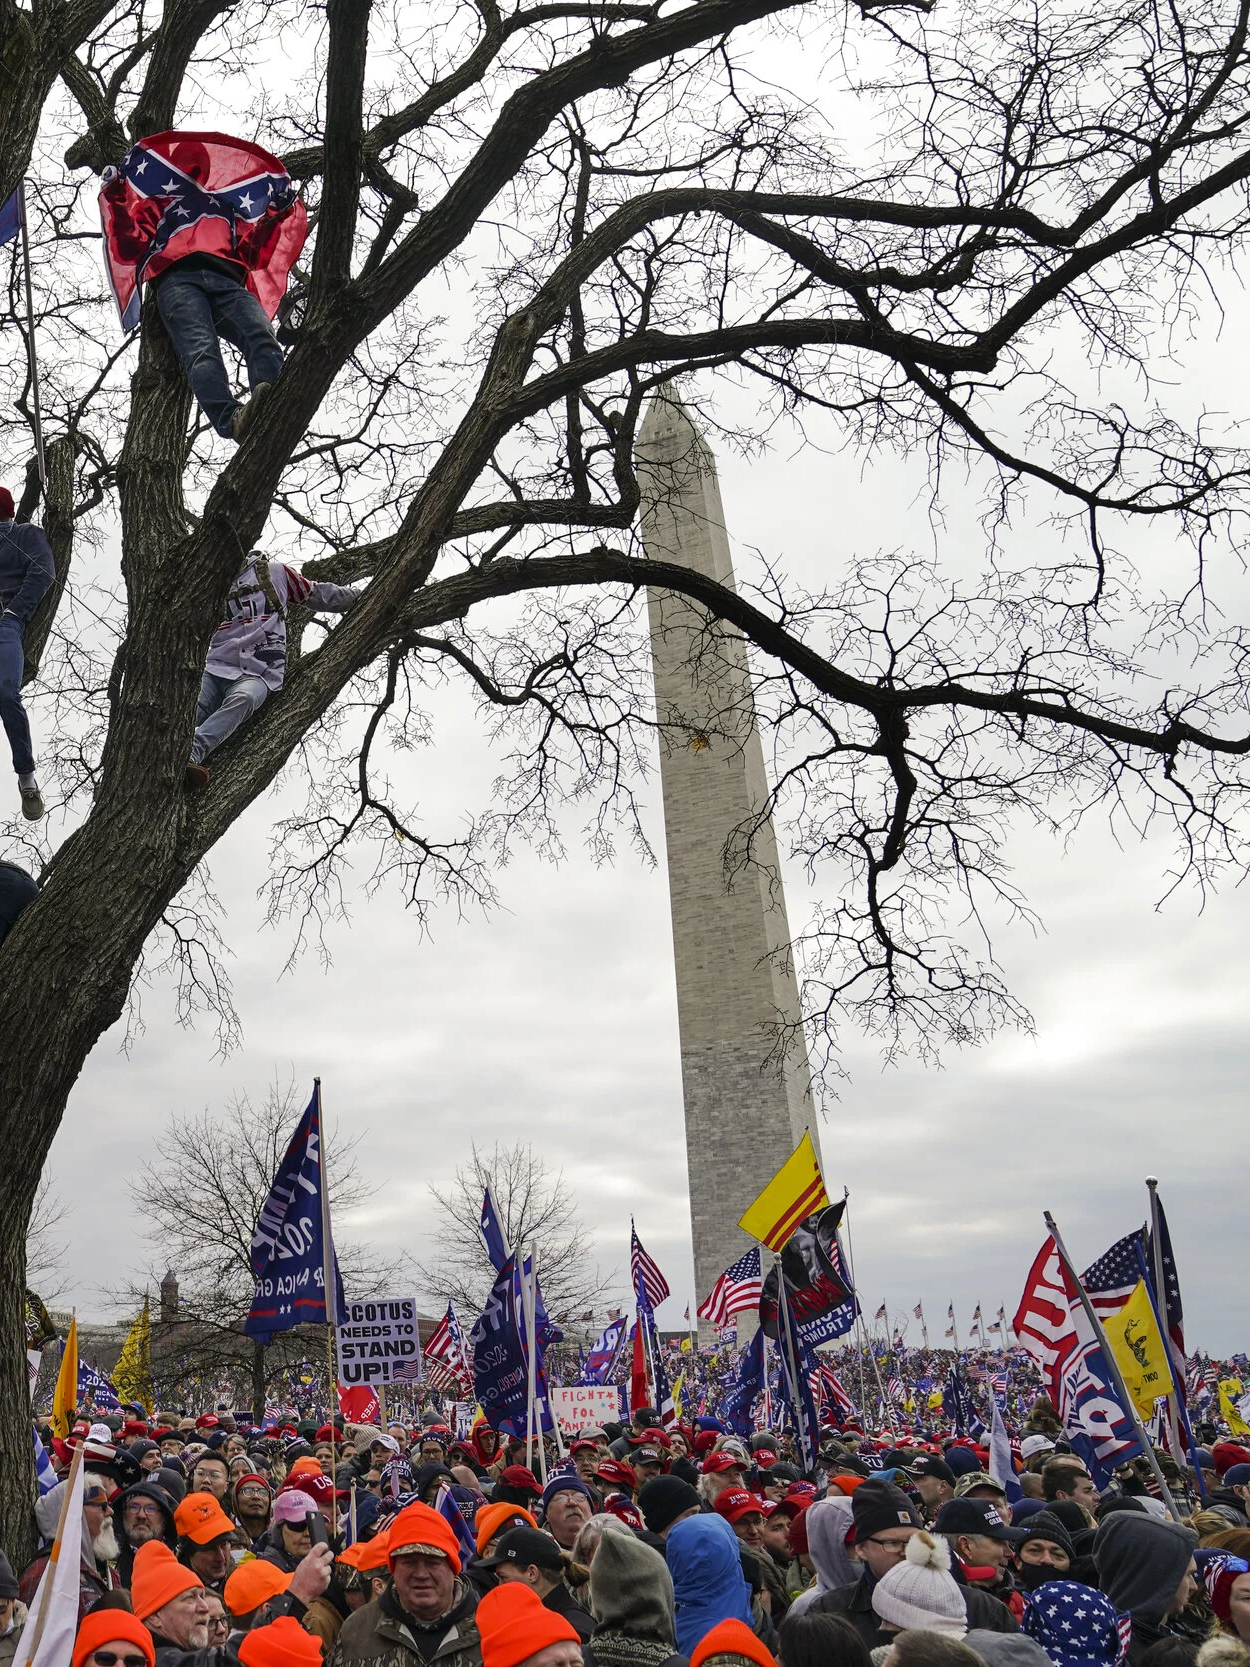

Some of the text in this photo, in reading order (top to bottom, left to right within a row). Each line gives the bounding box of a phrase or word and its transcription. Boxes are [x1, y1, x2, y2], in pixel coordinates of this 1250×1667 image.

[341, 1324, 414, 1338] NEEDS TO
[341, 1340, 416, 1359] STAND
[342, 1361, 390, 1382] UP!
[562, 1390, 605, 1401] FIGHT
[361, 1399, 377, 1419] KEEP
[573, 1407, 594, 1419] FOR
[387, 1467, 409, 1477] 220
[313, 1475, 334, 1490] US
